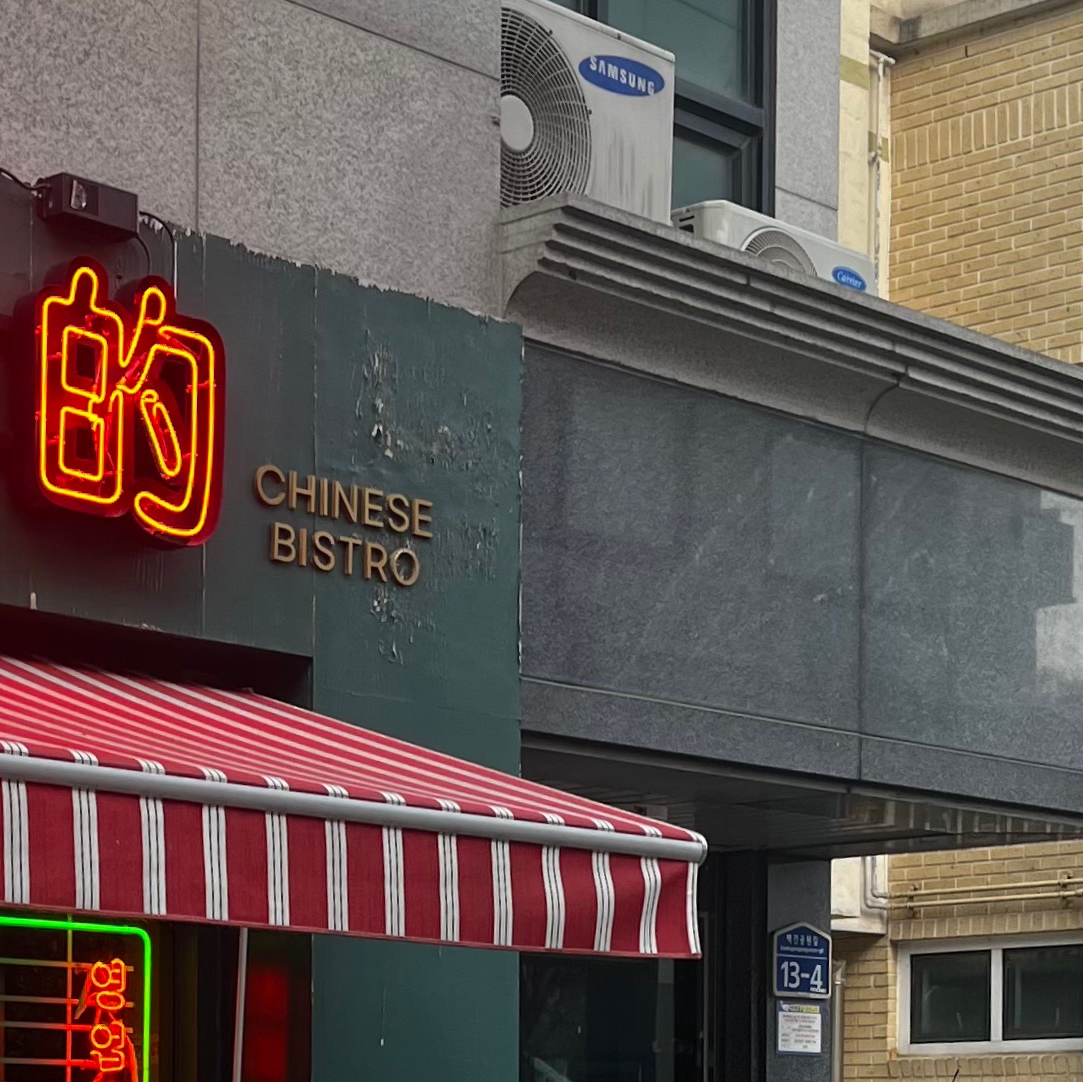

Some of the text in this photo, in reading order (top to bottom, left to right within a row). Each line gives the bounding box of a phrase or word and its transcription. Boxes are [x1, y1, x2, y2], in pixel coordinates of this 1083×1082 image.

[589, 56, 655, 96] SAMSUNG
[254, 464, 434, 539] CHINESE
[271, 522, 420, 587] BISTRO
[781, 961, 824, 992] 13-4
